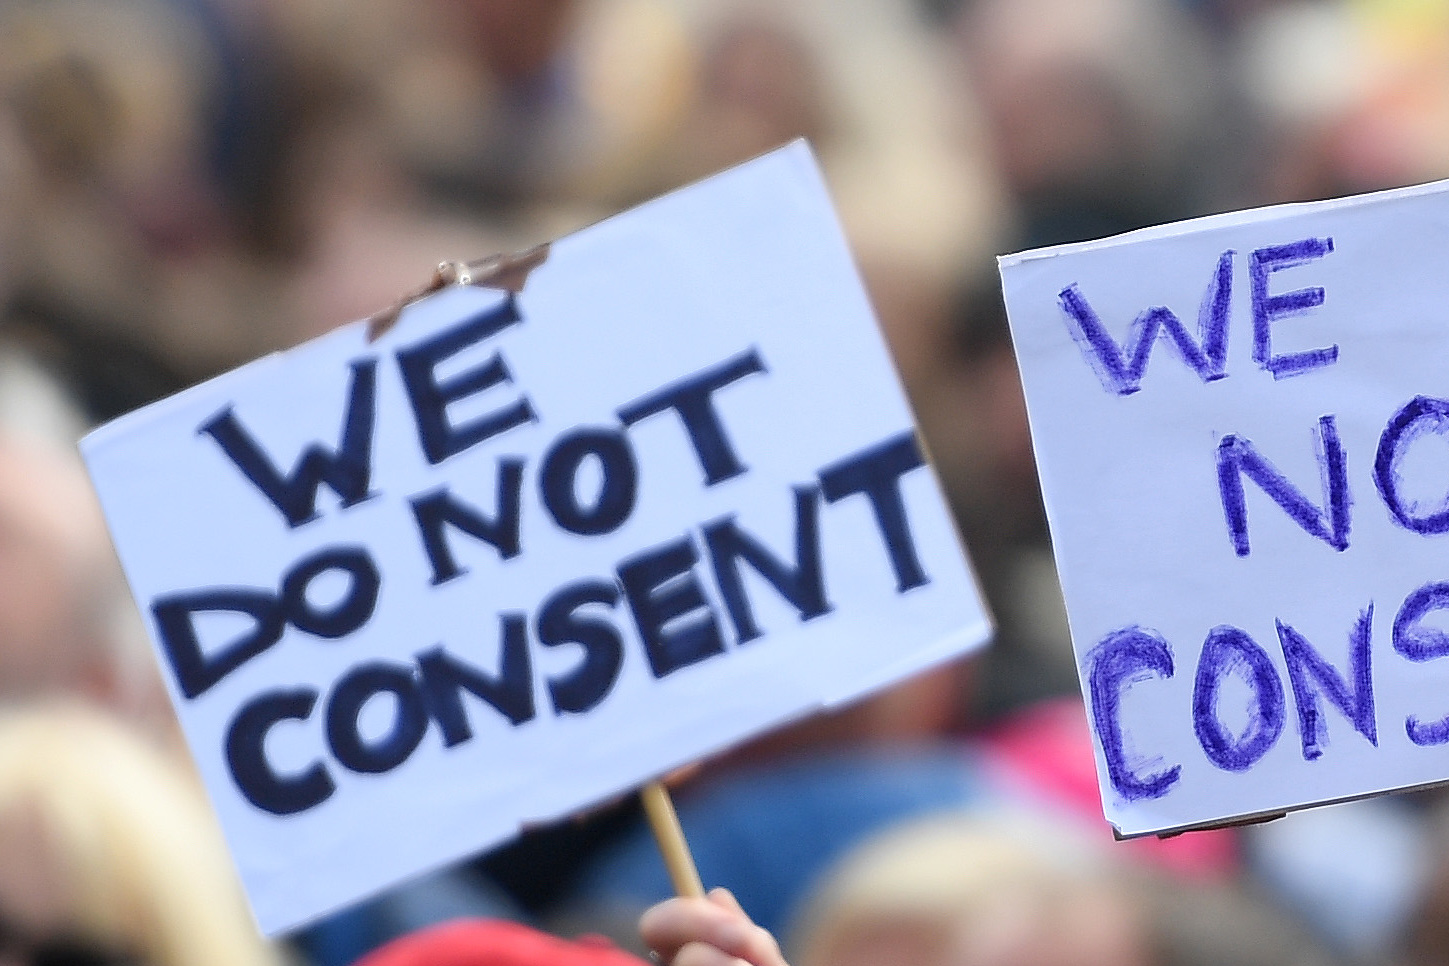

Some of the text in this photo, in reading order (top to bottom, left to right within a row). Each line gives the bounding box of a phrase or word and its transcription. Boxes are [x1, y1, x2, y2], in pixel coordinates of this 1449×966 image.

[197, 292, 537, 529] WE
[1057, 236, 1339, 394] WE
[150, 345, 769, 700] DO NOT
[225, 429, 929, 815] CONSENT
